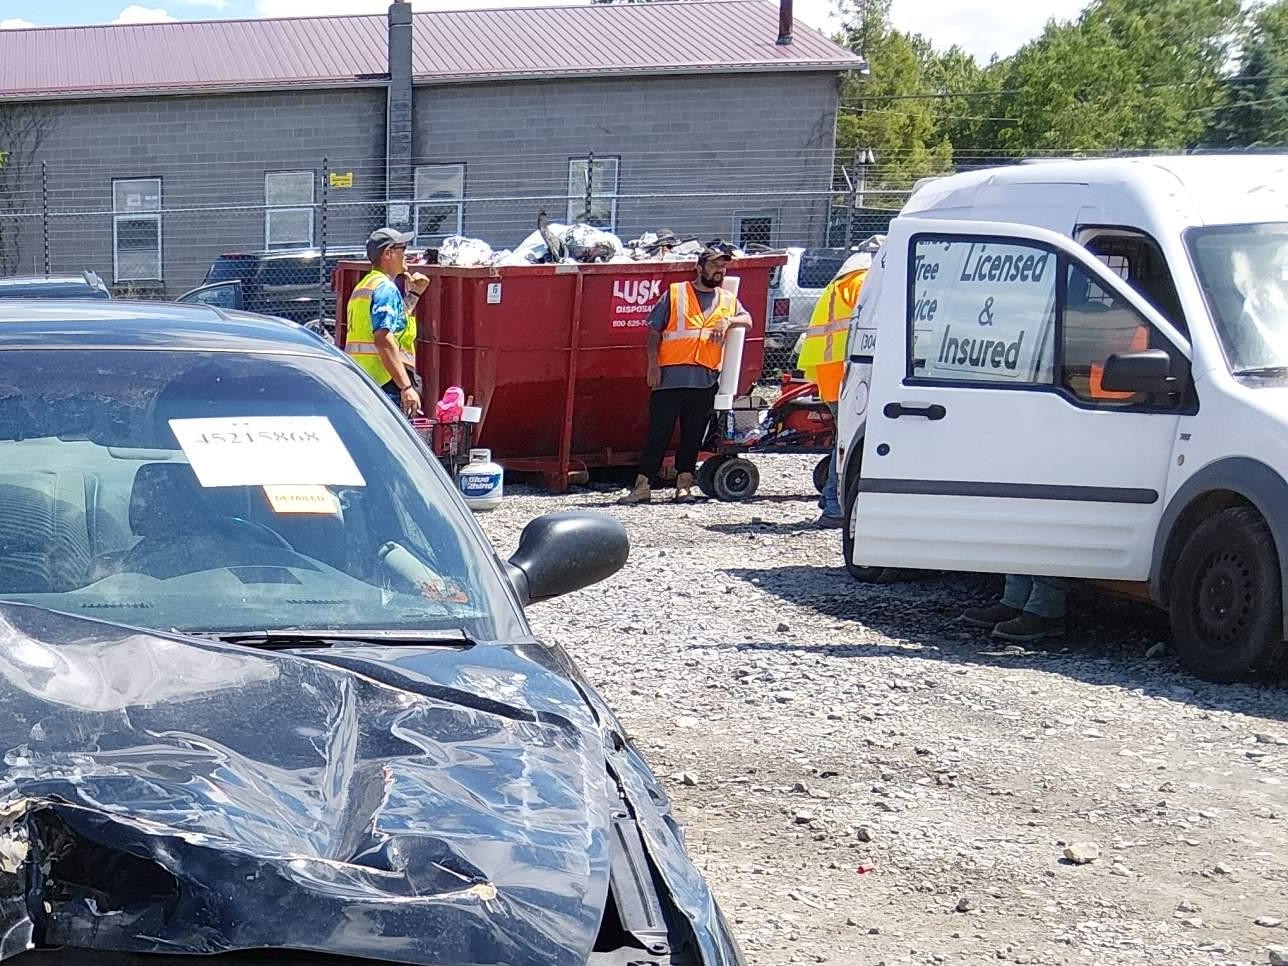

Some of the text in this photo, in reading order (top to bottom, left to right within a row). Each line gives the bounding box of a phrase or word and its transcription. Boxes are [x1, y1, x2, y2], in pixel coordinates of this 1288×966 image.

[915, 255, 940, 281] Tree
[960, 243, 1049, 282] Licensed
[613, 280, 662, 304] LUSK
[978, 296, 995, 326] &
[938, 324, 1025, 370] Insured
